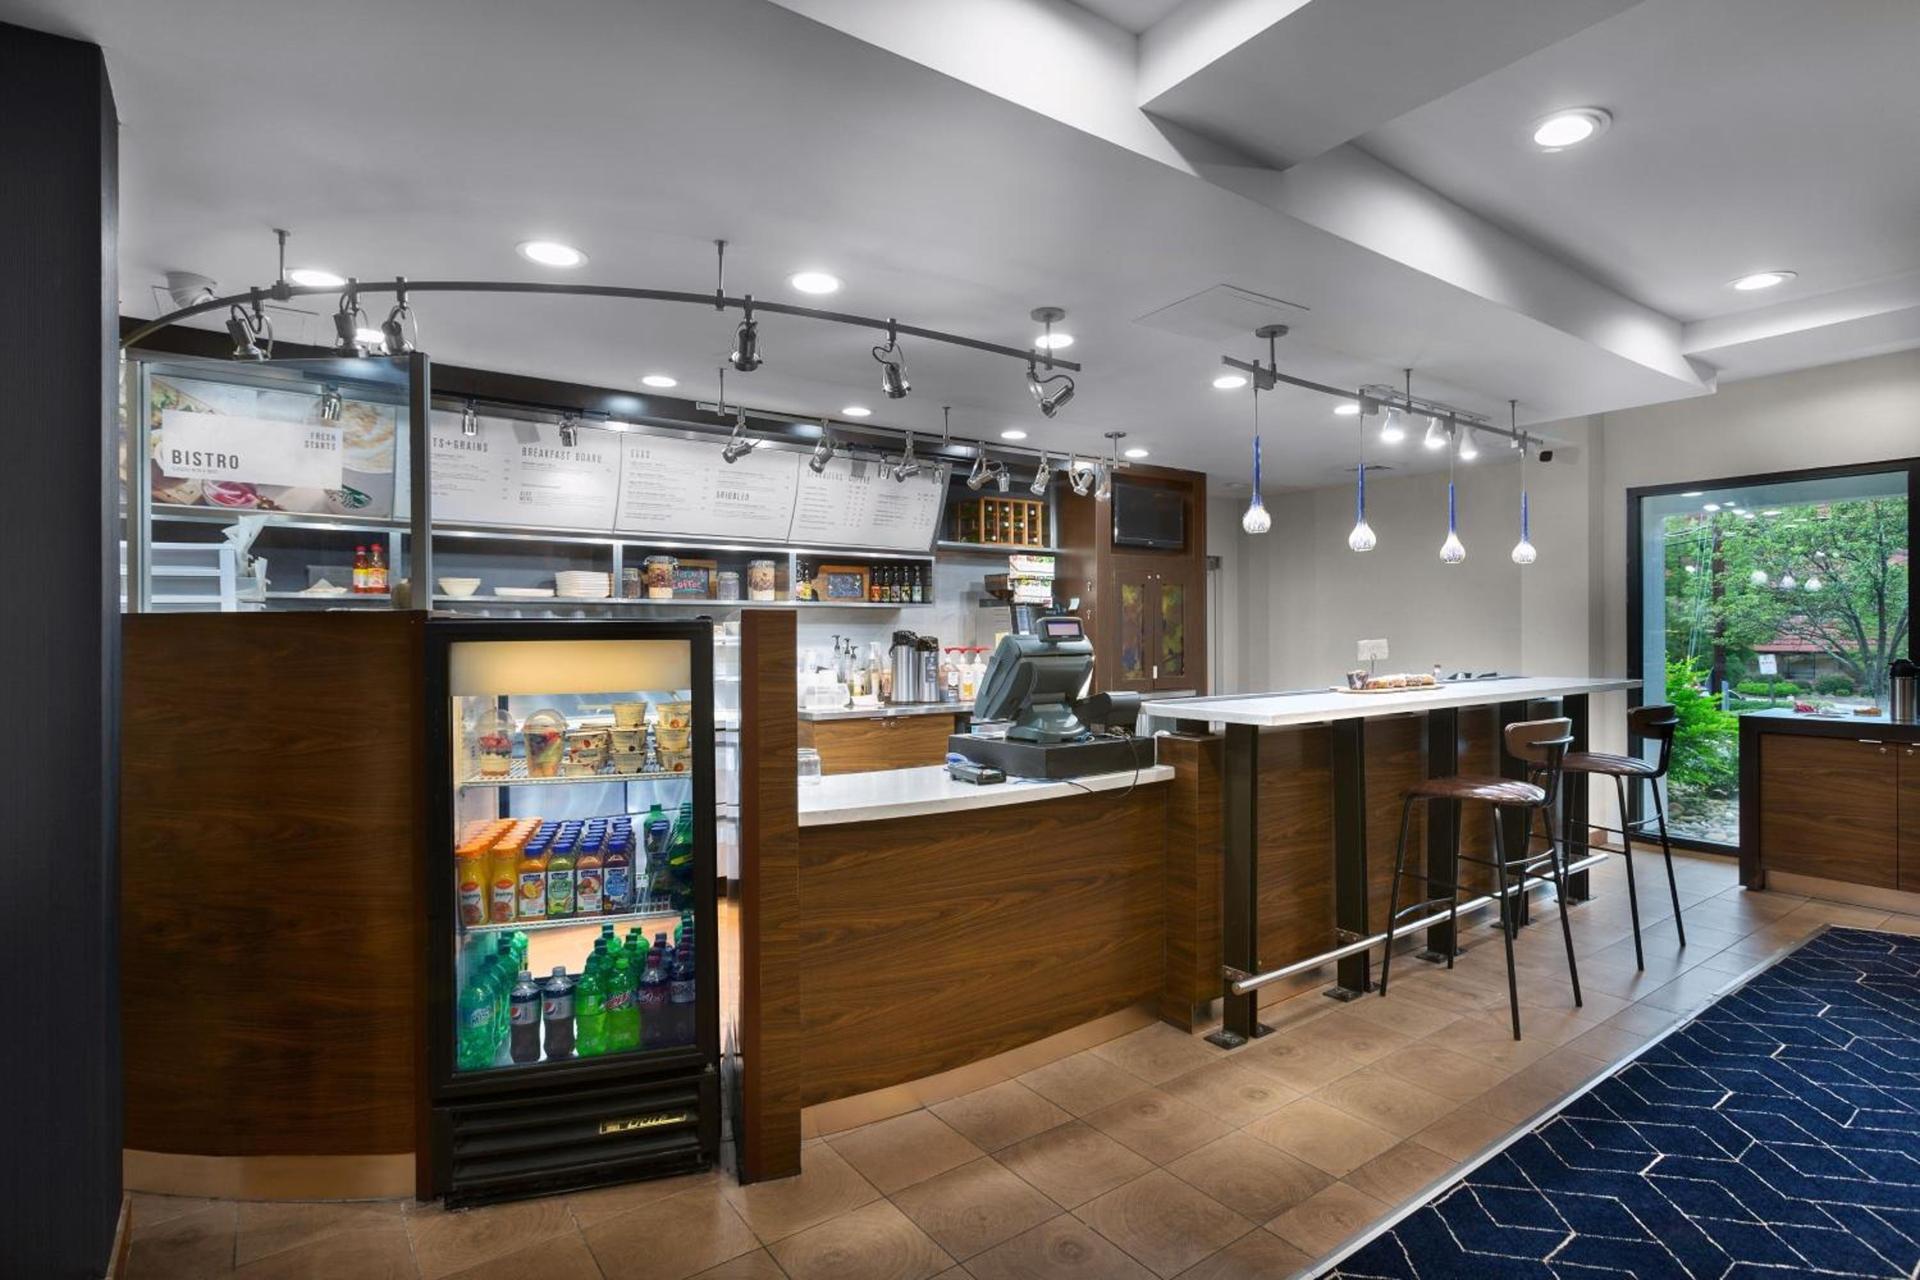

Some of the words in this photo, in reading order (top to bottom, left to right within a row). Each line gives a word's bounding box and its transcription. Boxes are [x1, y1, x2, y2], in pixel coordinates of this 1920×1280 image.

[171, 449, 240, 470] BISTRO
[521, 446, 571, 461] BREAKFAST
[575, 452, 602, 465] BOARD
